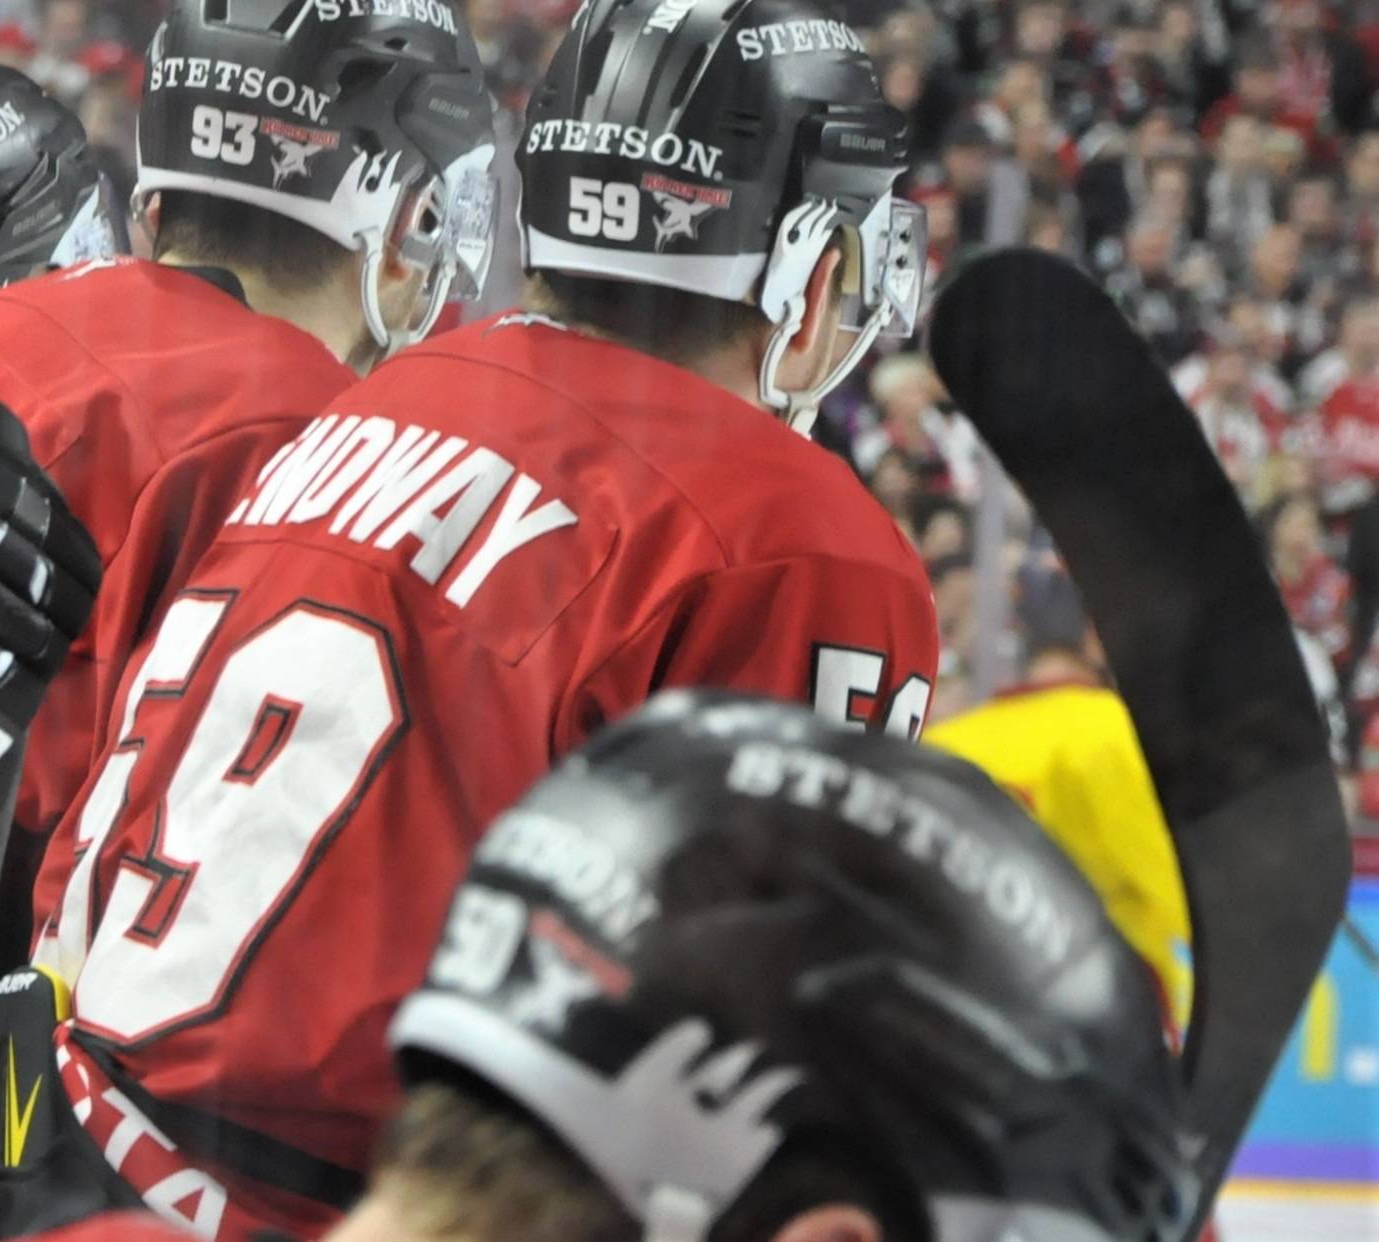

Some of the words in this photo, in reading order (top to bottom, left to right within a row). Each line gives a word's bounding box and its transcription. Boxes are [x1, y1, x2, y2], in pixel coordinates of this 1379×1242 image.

[151, 57, 329, 125] STETSON
[190, 105, 258, 166] 93
[526, 120, 724, 180] STETSON
[568, 176, 640, 242] 59
[727, 740, 1075, 965] STETSON
